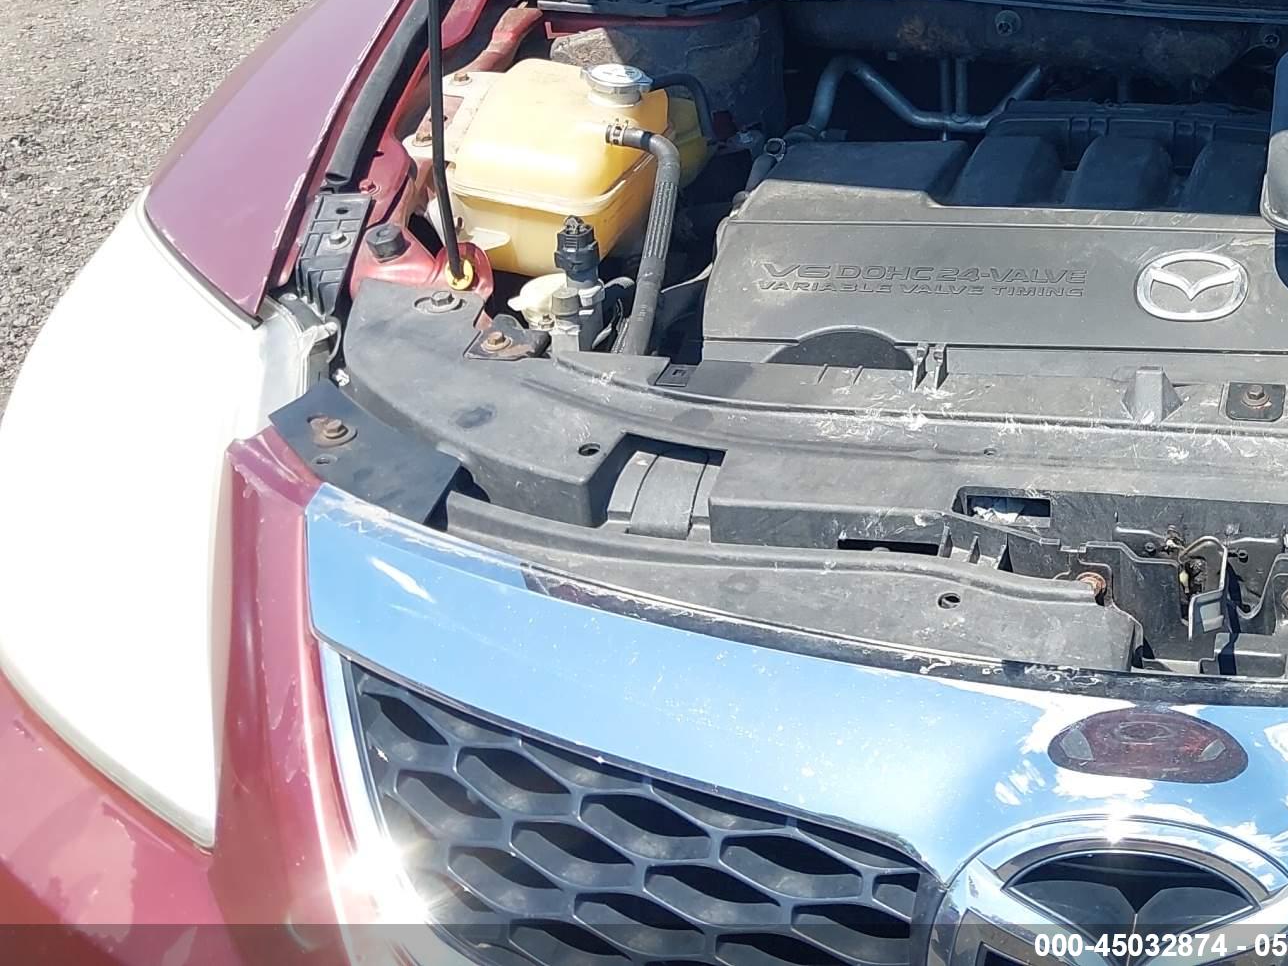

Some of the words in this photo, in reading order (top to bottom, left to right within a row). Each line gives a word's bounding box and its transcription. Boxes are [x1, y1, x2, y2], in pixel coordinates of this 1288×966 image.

[762, 263, 832, 279] V6
[834, 265, 934, 282] DOHC
[935, 266, 1088, 284] 24-VALVE
[757, 280, 892, 294] VARIABLE
[903, 283, 985, 296] VALVE
[991, 285, 1085, 298] TIMING
